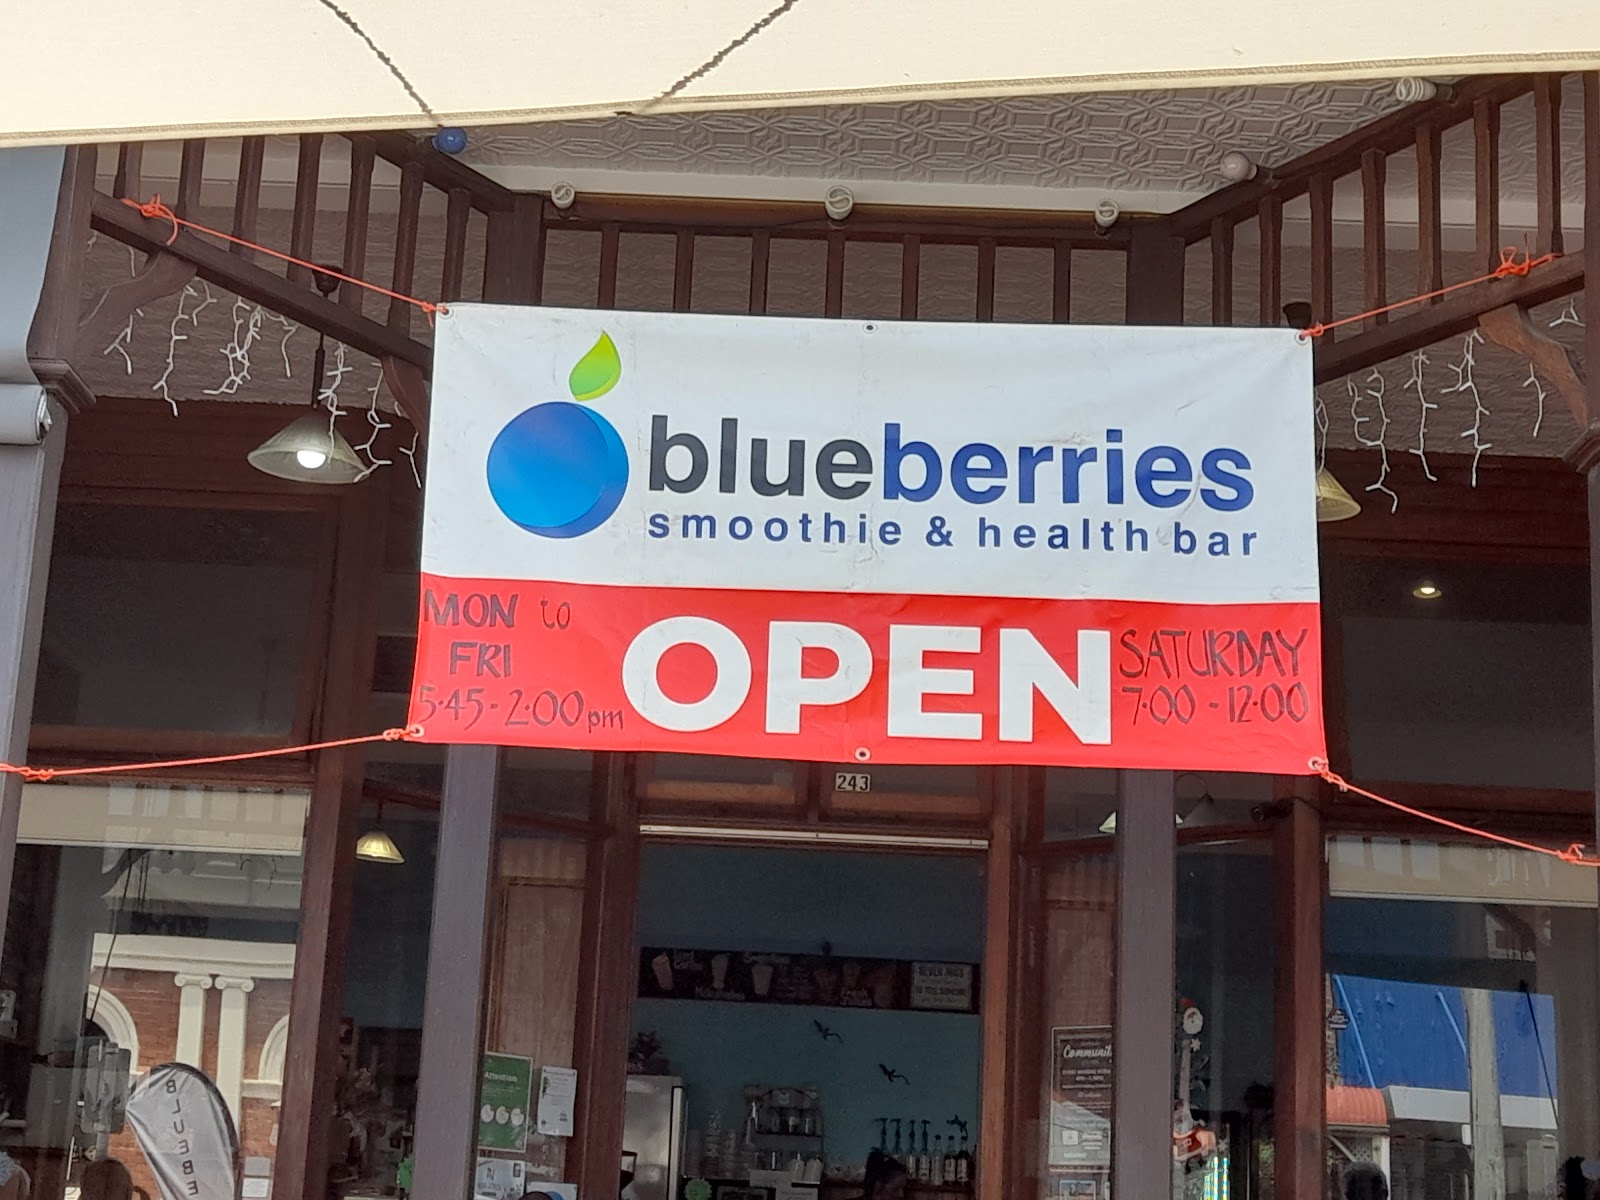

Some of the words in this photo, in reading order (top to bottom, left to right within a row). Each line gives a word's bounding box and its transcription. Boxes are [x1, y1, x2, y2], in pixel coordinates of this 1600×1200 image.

[648, 415, 1254, 512] blueberries
[648, 513, 901, 546] smoothie
[925, 517, 954, 547] &
[979, 518, 1149, 552] health
[1175, 523, 1258, 557] bar
[424, 588, 518, 628] MON
[540, 596, 571, 629] to
[450, 641, 511, 678] FRI
[1119, 629, 1308, 679] SATURDAY
[622, 616, 1111, 745] OPEN
[837, 774, 869, 791] 243
[1063, 1044, 1112, 1059] Communit
